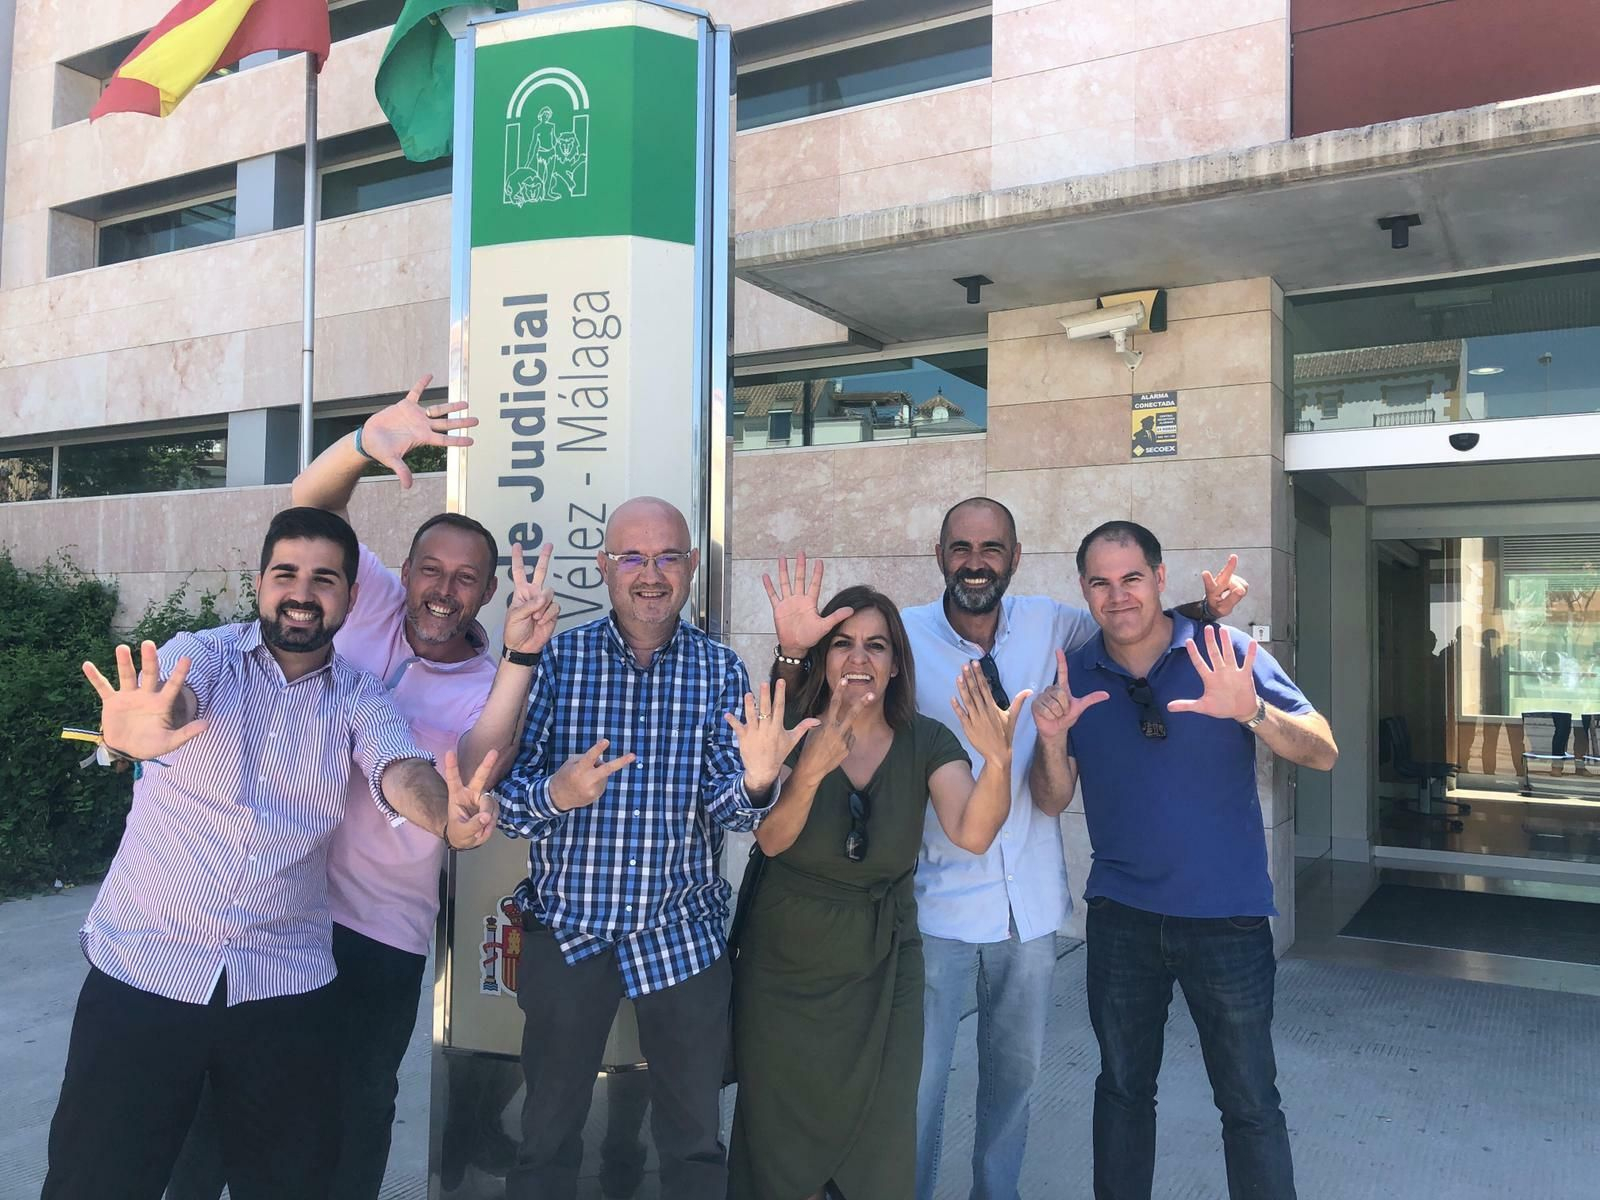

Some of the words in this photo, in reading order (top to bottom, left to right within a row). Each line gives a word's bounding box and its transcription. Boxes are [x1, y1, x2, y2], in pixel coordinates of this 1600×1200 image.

[498, 293, 548, 502] Judicial
[556, 290, 622, 451] Málaga
[1134, 400, 1175, 409] CONECTADA
[1145, 445, 1176, 453] SECOEX
[553, 503, 607, 619] Vélez
